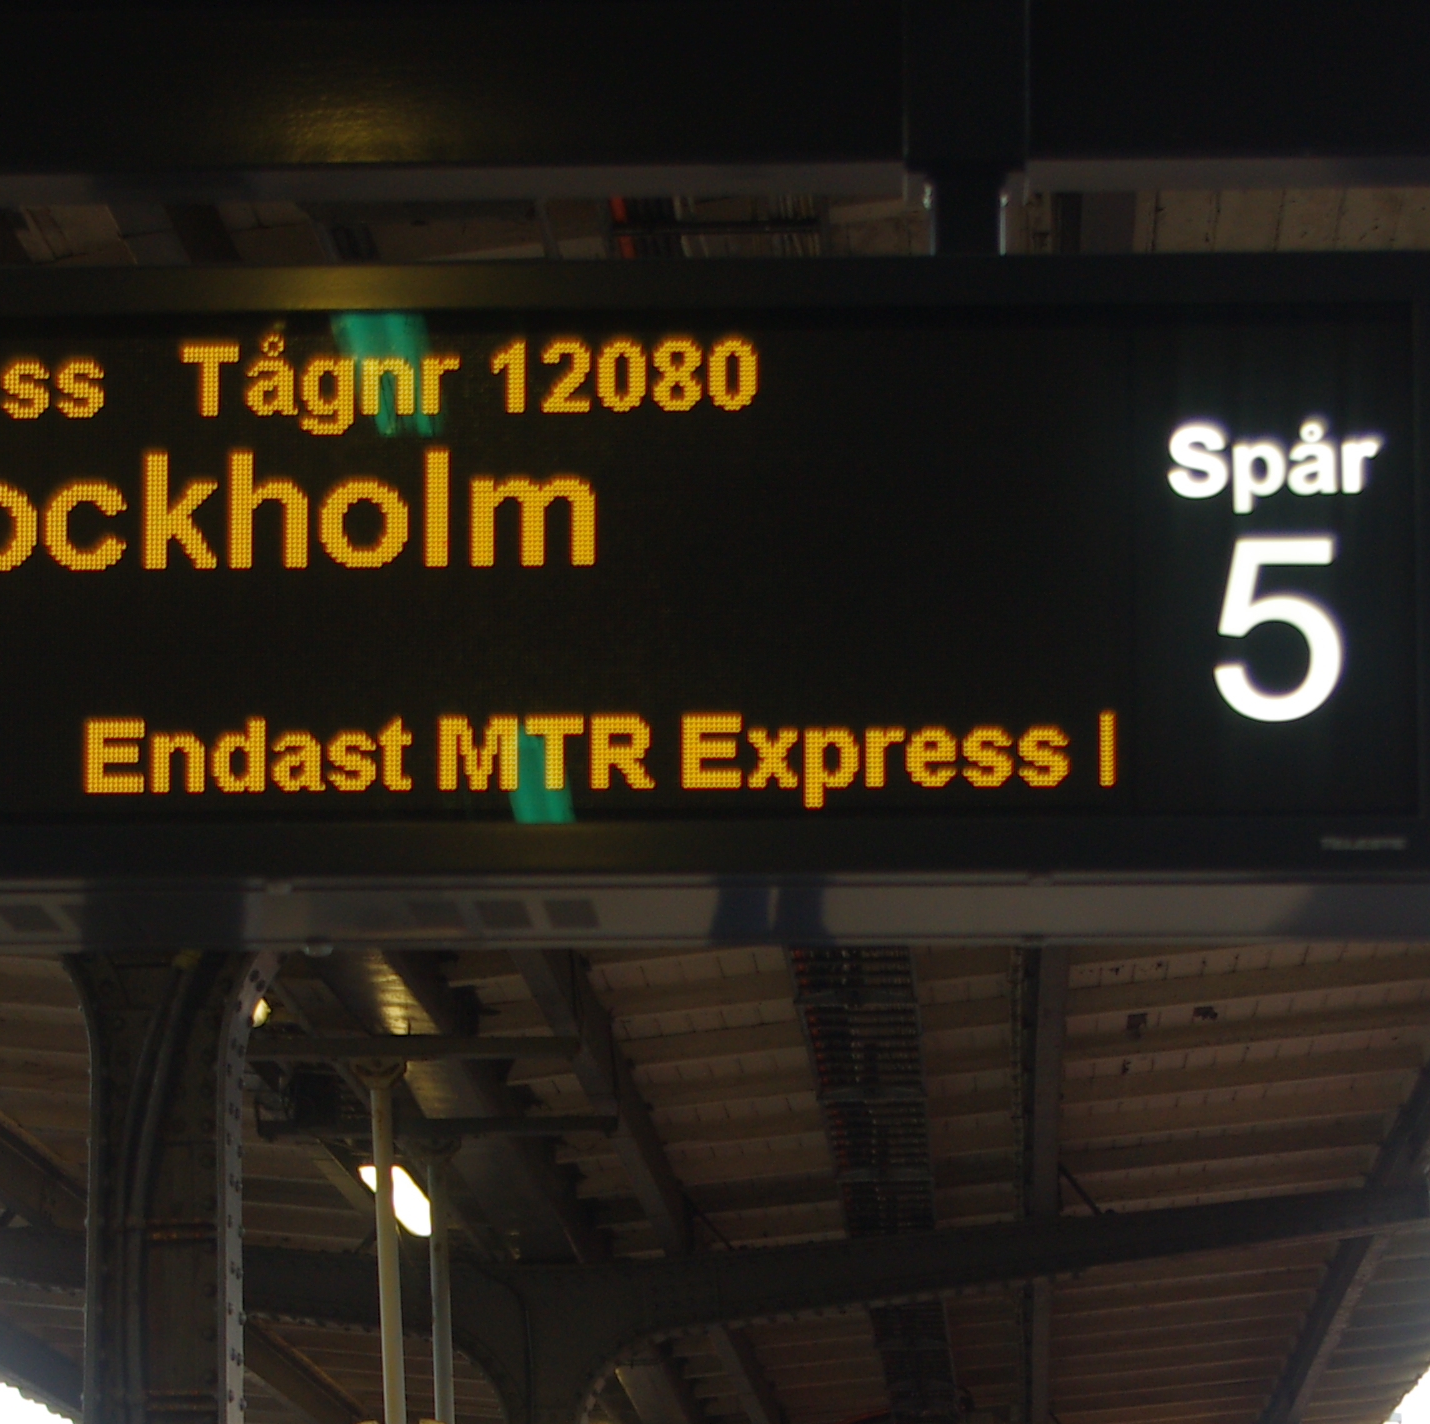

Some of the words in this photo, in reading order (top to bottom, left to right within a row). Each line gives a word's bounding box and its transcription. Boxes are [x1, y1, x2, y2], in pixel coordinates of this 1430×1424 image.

[179, 334, 461, 436] Tågnr
[490, 337, 759, 413] 12080
[1167, 418, 1382, 513] Spår
[1212, 535, 1343, 723] 5
[82, 716, 413, 794] Endast
[437, 713, 656, 791] MTR
[680, 712, 1070, 809] Express
